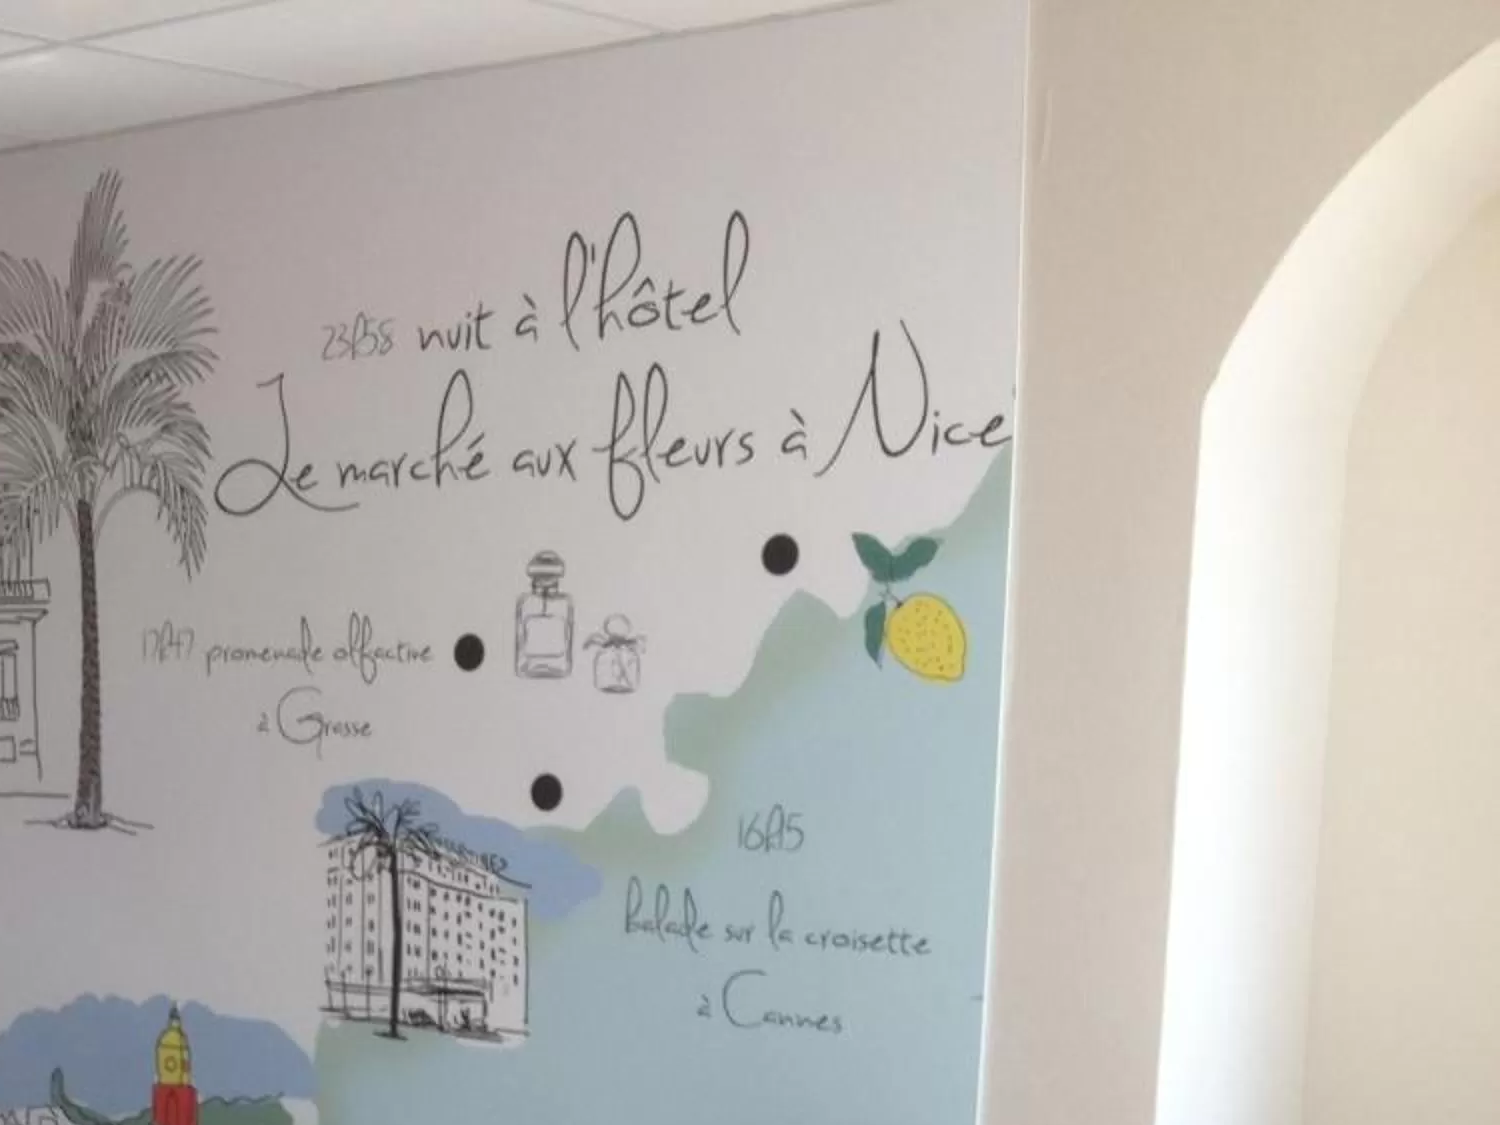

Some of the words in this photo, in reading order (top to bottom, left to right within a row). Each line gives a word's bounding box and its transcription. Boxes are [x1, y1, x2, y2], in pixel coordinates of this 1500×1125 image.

[417, 300, 495, 351] nuit
[514, 292, 538, 342] à
[560, 210, 750, 351] l'hôtel
[213, 371, 360, 516] Le
[336, 368, 490, 488] marché
[512, 438, 577, 481] aux
[591, 361, 754, 521] fleurs
[780, 407, 807, 460] à
[812, 318, 1013, 478] Nice
[204, 614, 324, 677] promenade
[332, 610, 435, 685] olfactive
[257, 711, 271, 733] à
[276, 685, 373, 761] Grasse
[624, 875, 713, 953] balade
[724, 923, 756, 943] sur
[768, 889, 794, 951] la
[803, 924, 932, 956] croisette
[697, 993, 712, 1018] à
[722, 969, 843, 1033] Cannes
